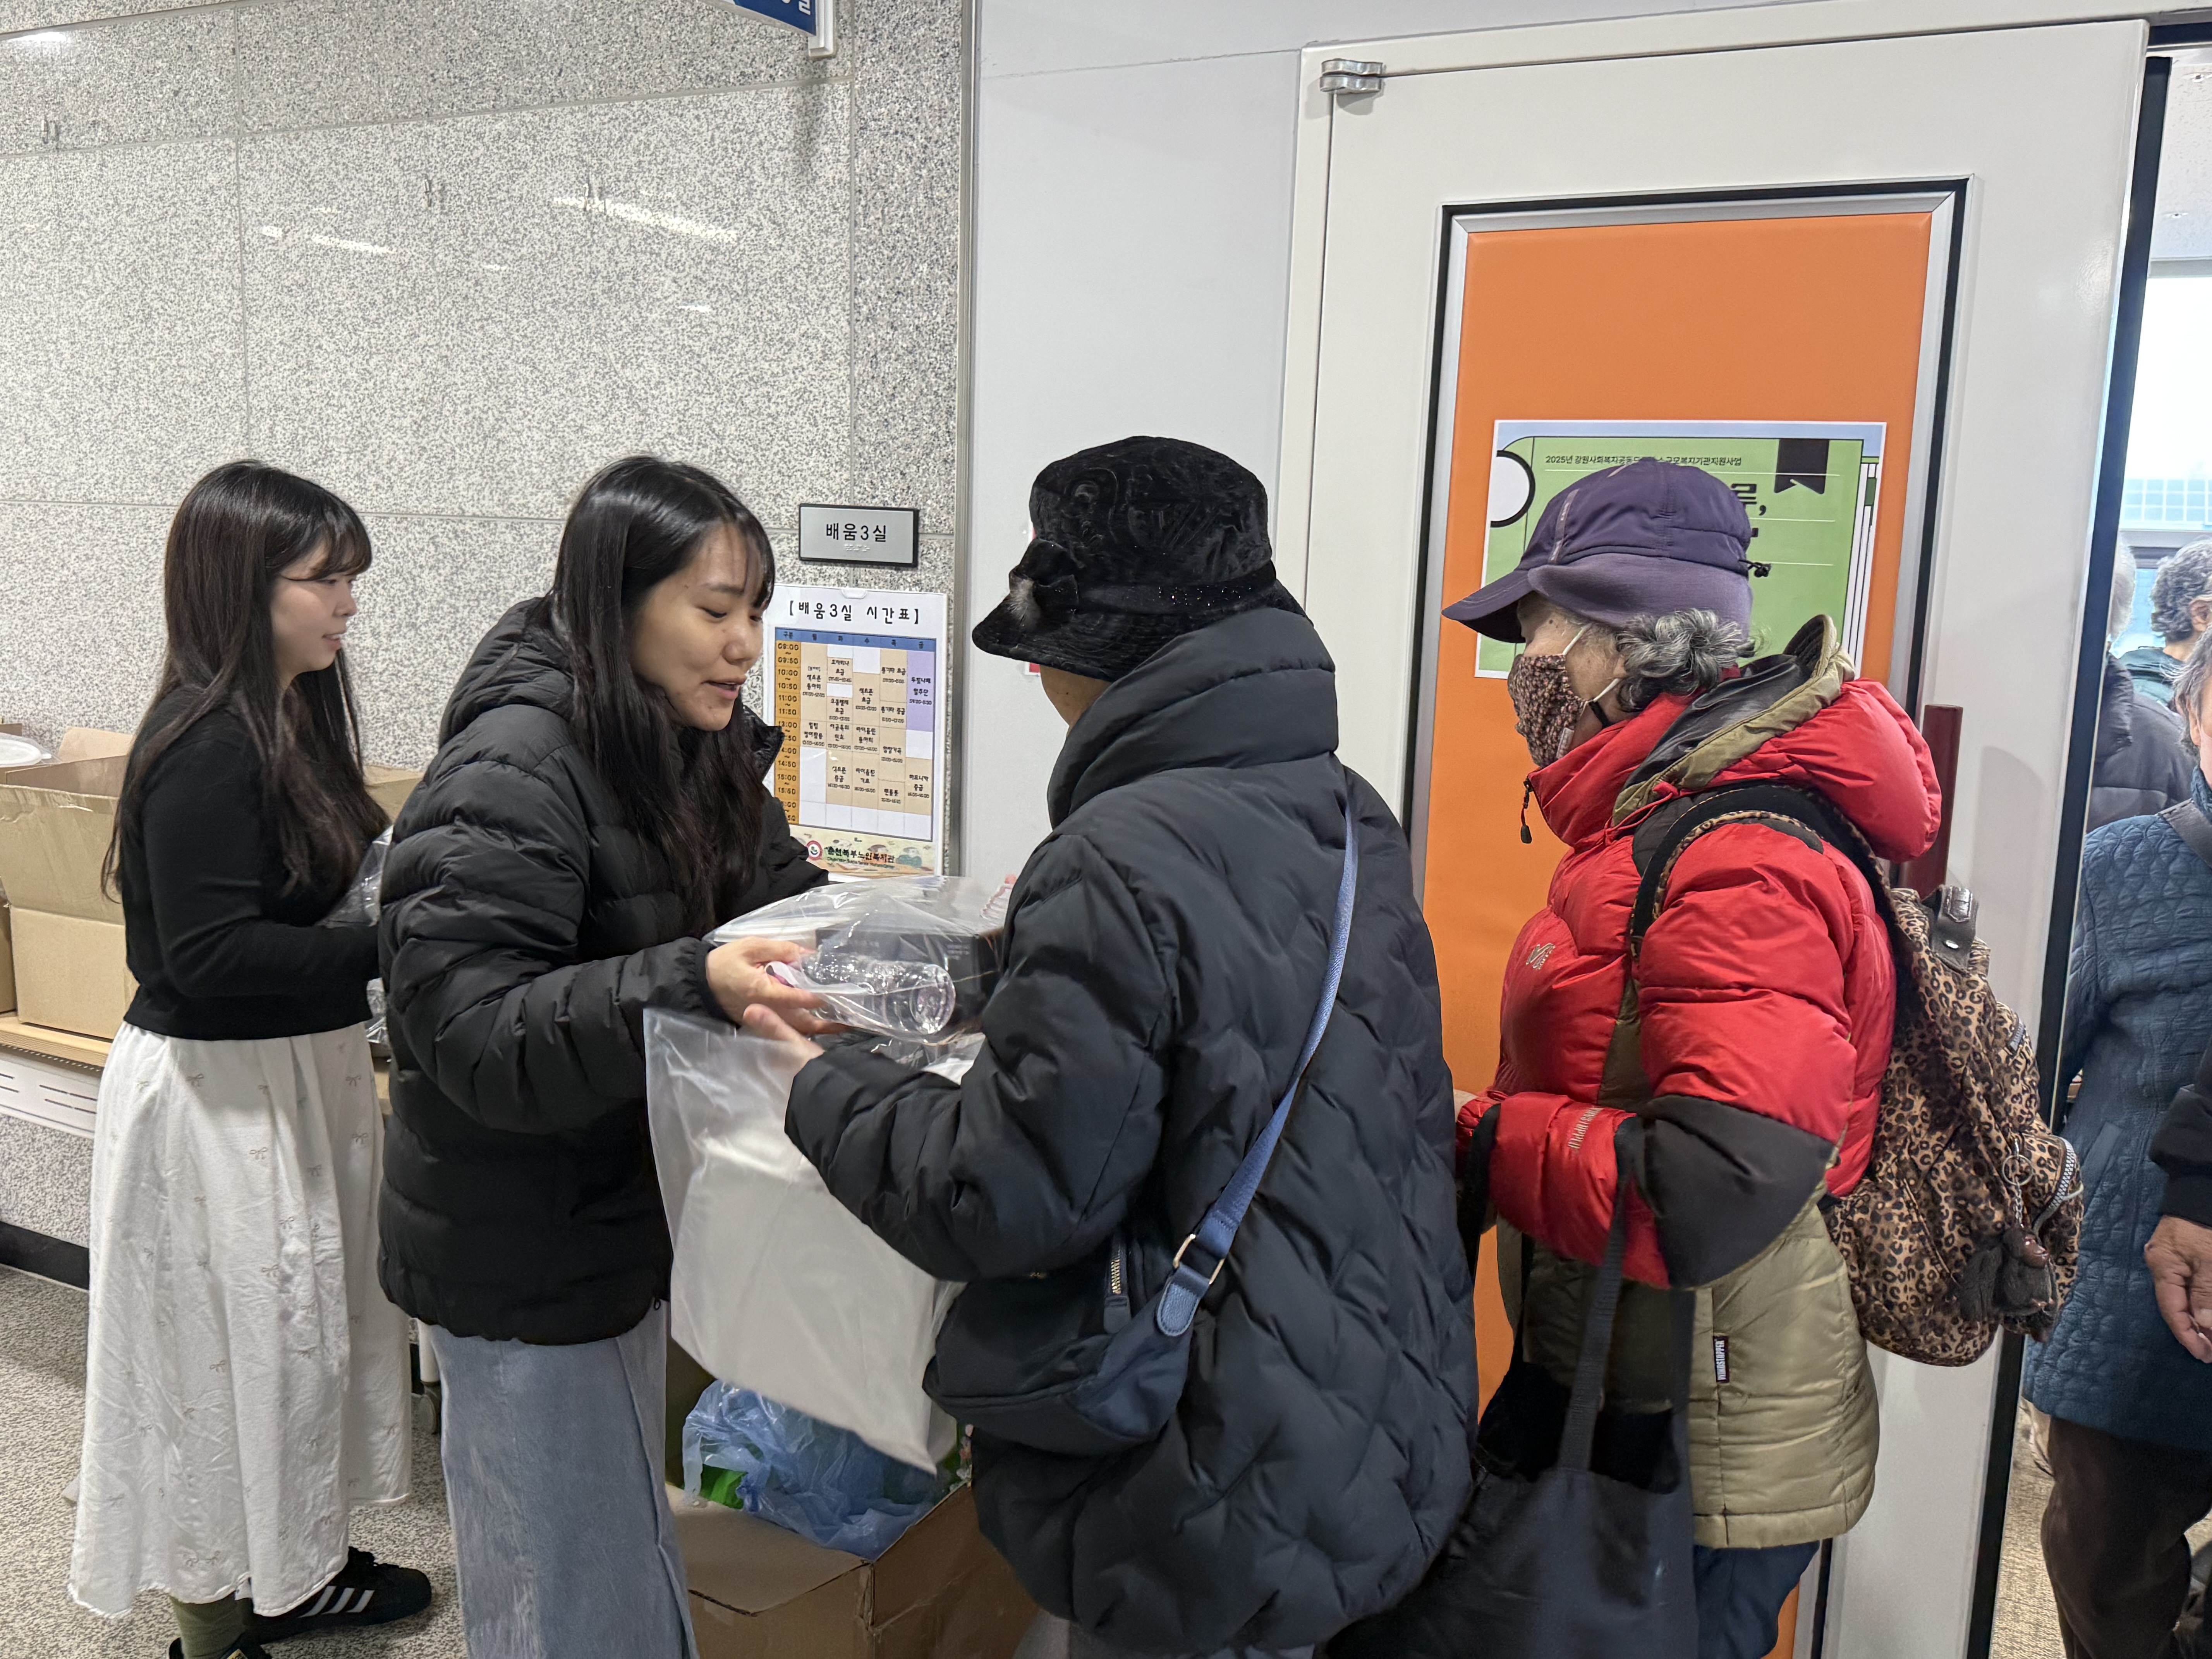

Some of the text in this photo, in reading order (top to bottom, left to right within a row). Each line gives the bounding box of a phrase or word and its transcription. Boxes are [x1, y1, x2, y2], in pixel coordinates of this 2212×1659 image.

[1545, 455, 1573, 464] 2025년
[1575, 456, 1640, 465] 강원사회복지공동
[826, 523, 886, 542] 배움3실
